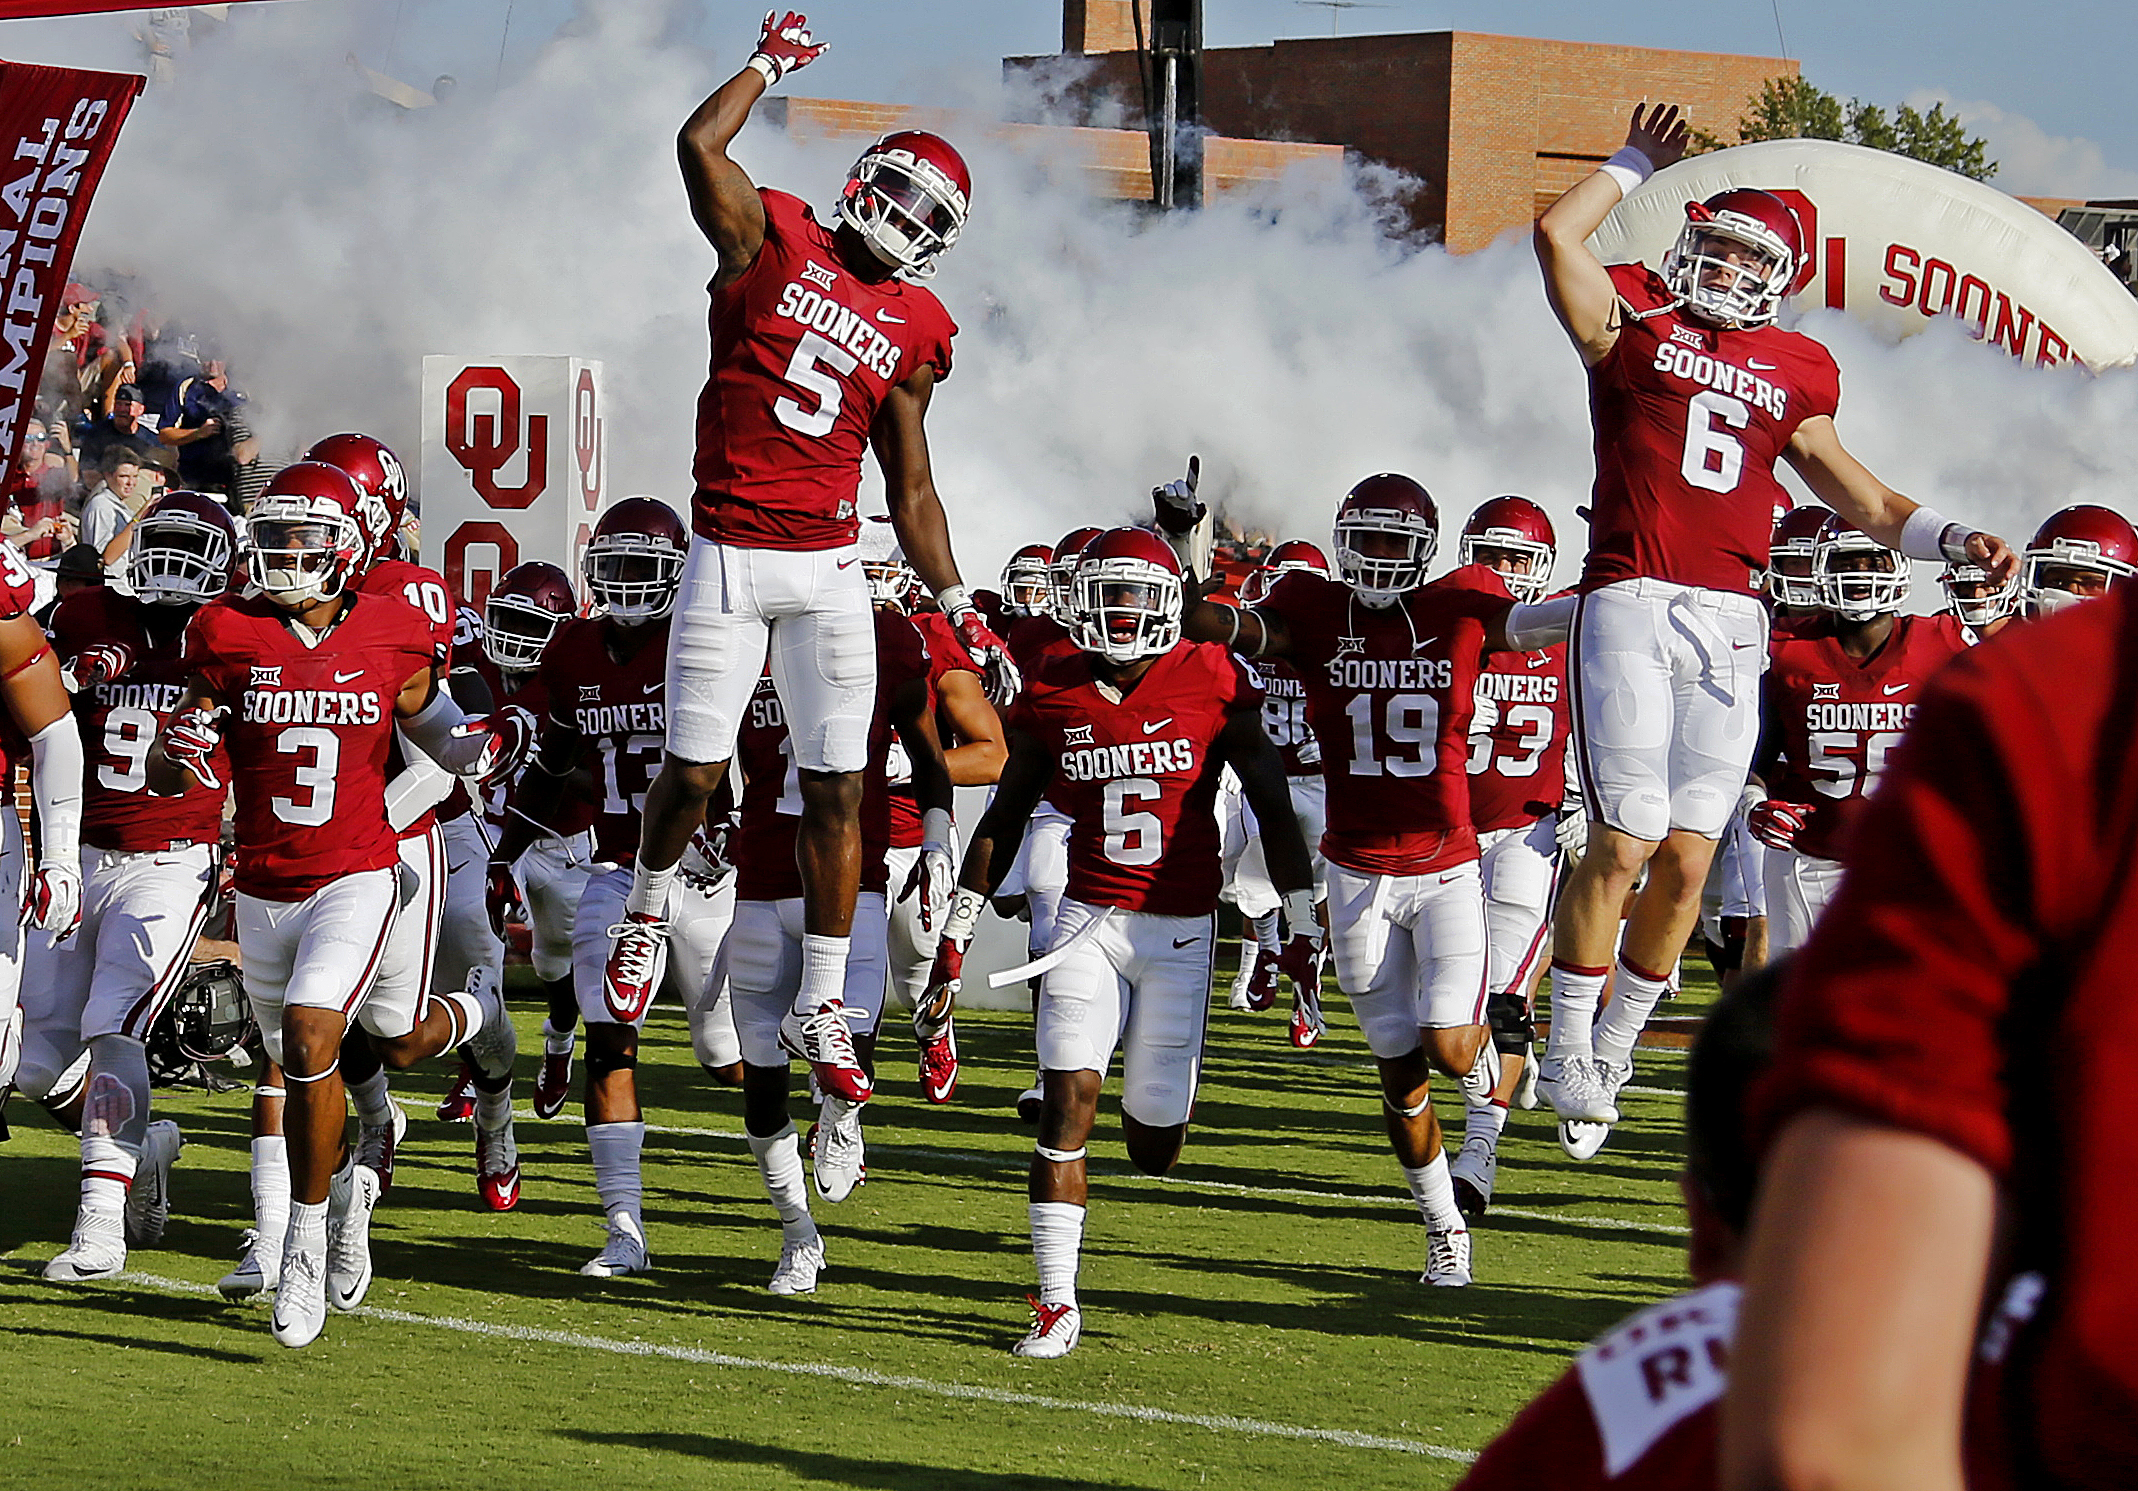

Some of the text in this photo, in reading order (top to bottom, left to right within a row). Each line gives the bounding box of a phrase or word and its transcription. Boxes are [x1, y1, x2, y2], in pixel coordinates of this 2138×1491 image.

[0, 97, 109, 485] AMPIONS
[776, 282, 903, 380] SOONERS
[1879, 243, 2093, 371] SOONE
[773, 330, 860, 437] 5
[1653, 342, 1787, 421] SOONERS
[445, 365, 549, 510] OU
[1681, 390, 1750, 494] 6
[403, 582, 448, 623] 10
[95, 683, 189, 713] SOONE
[243, 690, 381, 725] SOONERS
[1329, 659, 1452, 689] SOONERS
[1474, 672, 1559, 703] ONERS
[271, 726, 341, 827] 3
[1061, 738, 1194, 781] SOONERS
[1345, 693, 1439, 778] 19
[1103, 777, 1163, 866] 6
[360, 1176, 371, 1212] NIKE
